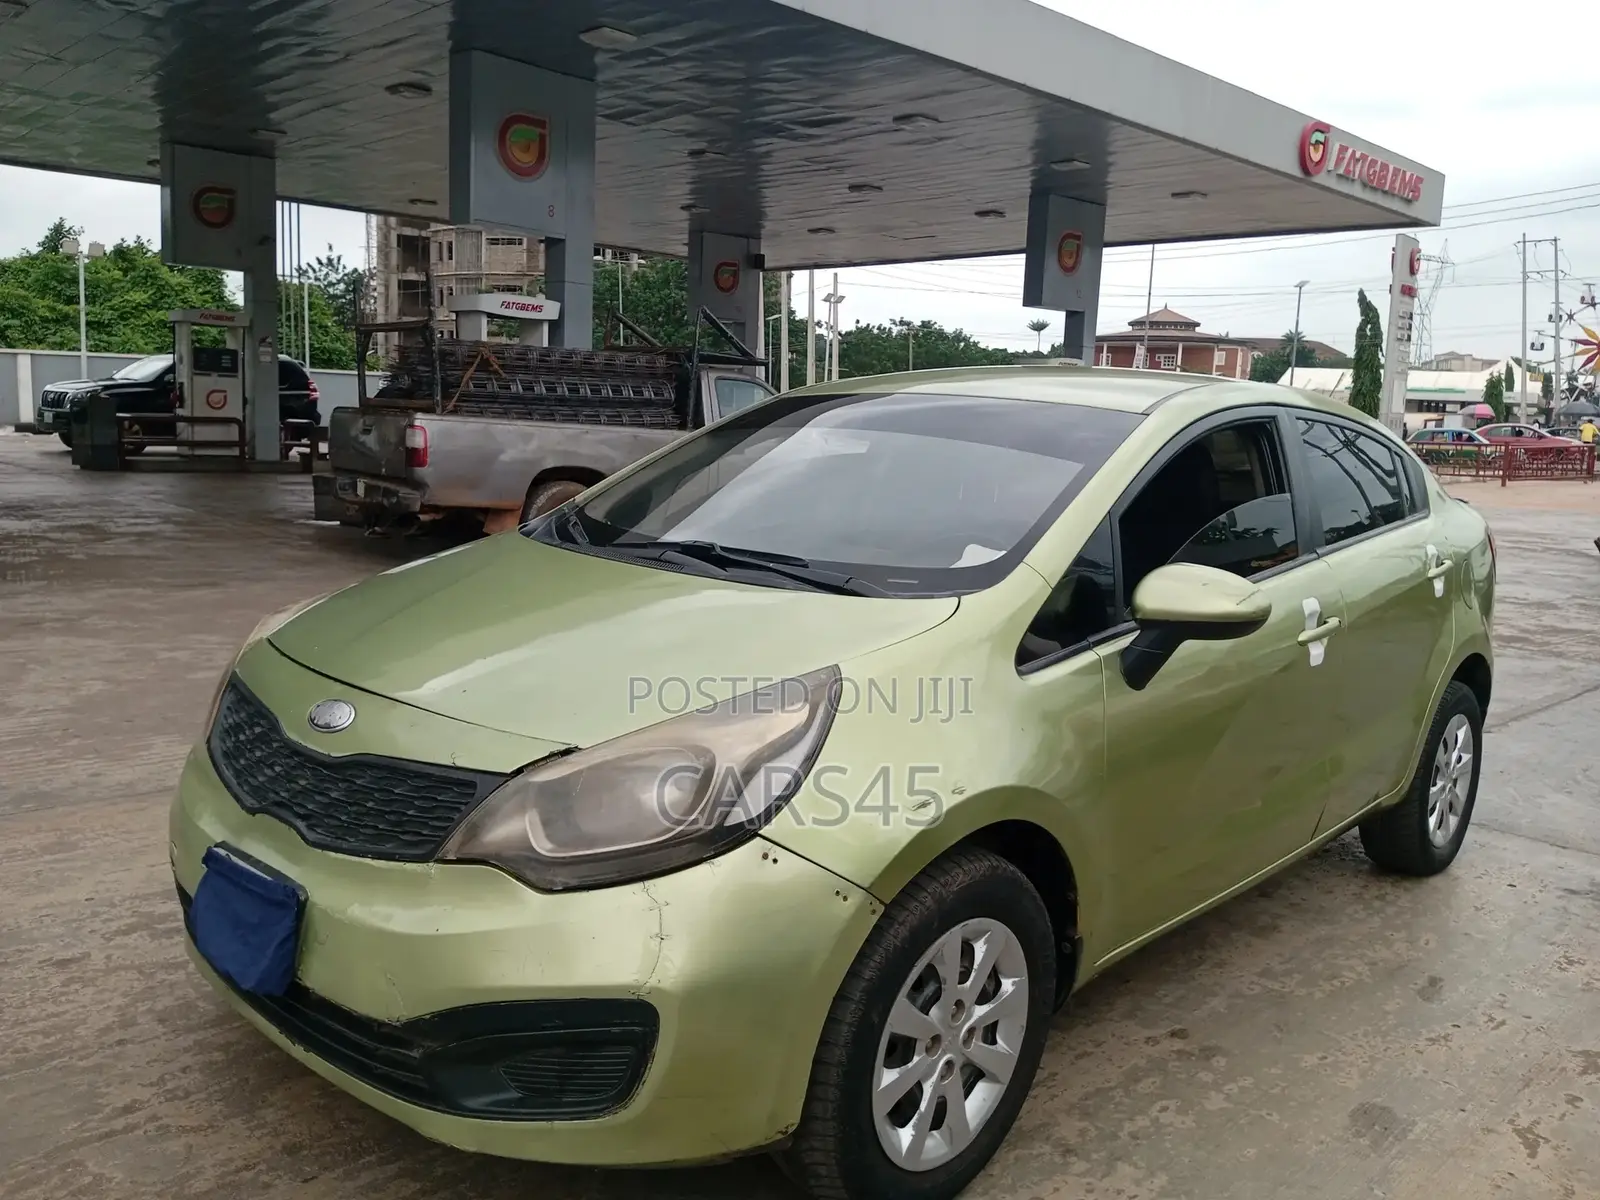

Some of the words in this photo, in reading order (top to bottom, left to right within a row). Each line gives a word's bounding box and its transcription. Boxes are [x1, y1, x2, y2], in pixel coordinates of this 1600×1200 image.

[1331, 143, 1424, 202] FATGBEMS
[548, 204, 555, 218] 8
[500, 300, 544, 313] FATGBEMS
